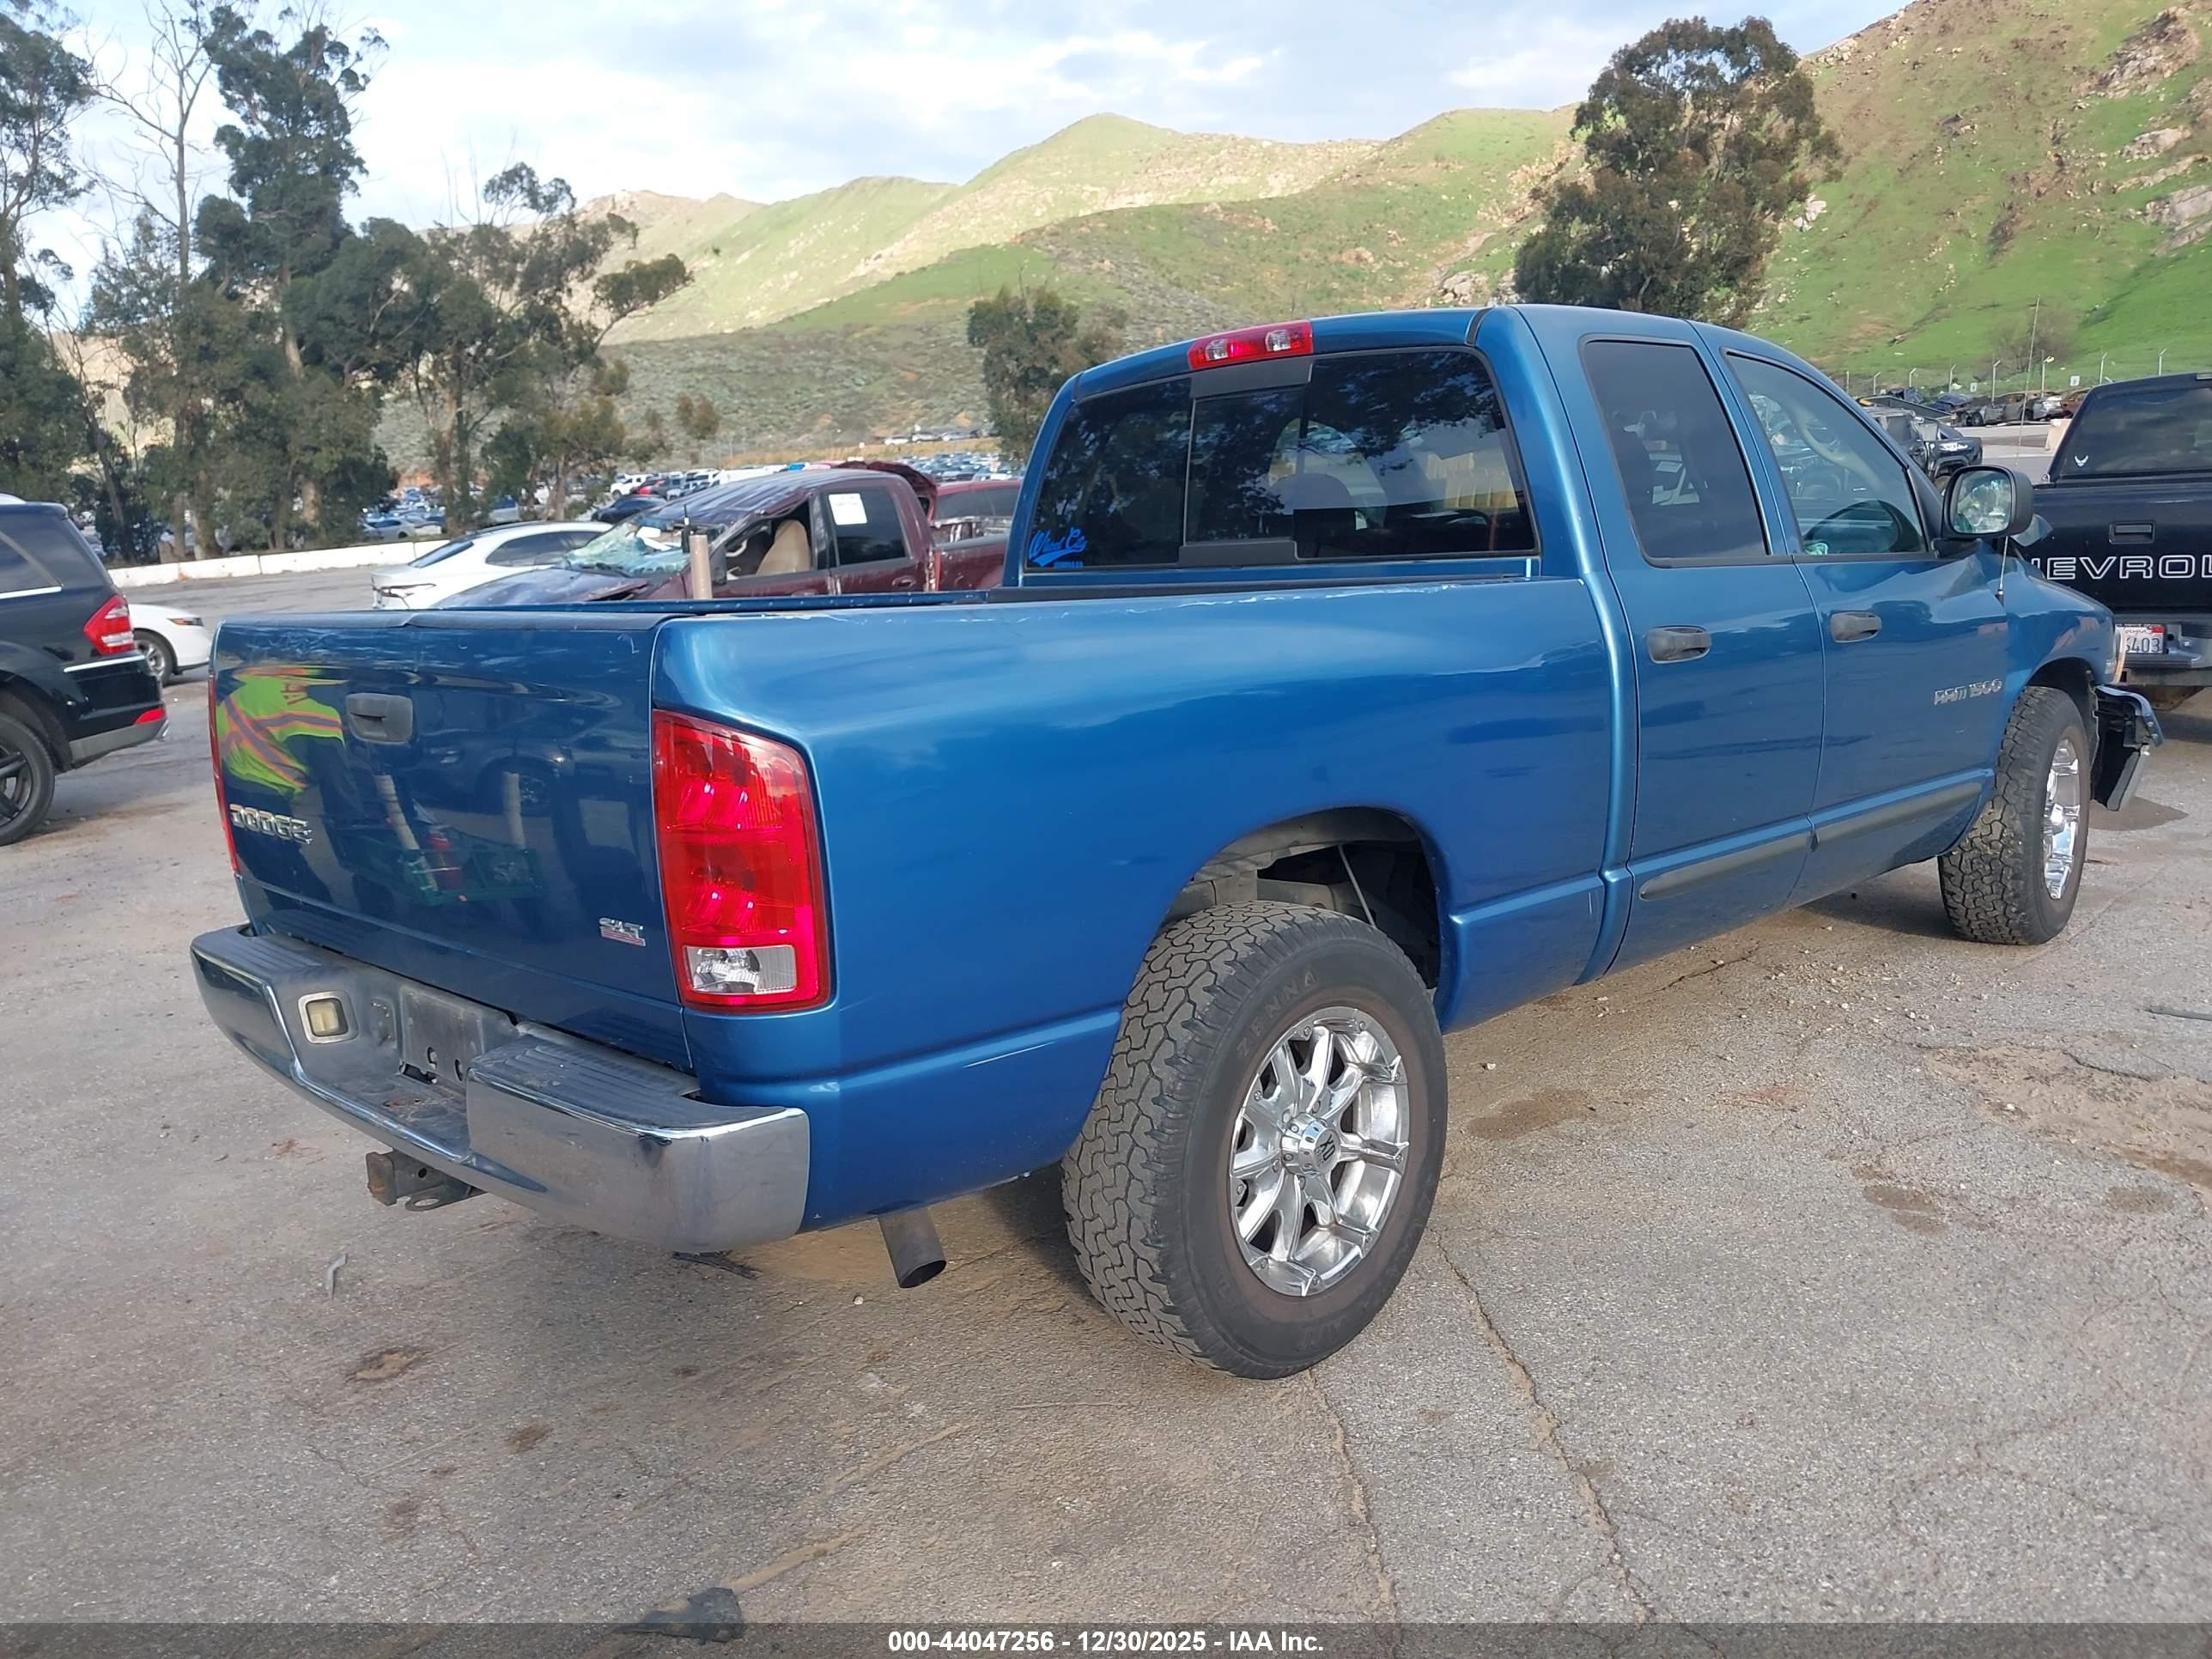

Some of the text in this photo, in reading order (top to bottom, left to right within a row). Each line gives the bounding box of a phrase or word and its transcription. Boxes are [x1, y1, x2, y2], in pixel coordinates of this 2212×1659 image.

[2032, 554, 2212, 580] EVROL
[1934, 678, 2002, 705] RAM 1500
[229, 803, 312, 845] DODGE
